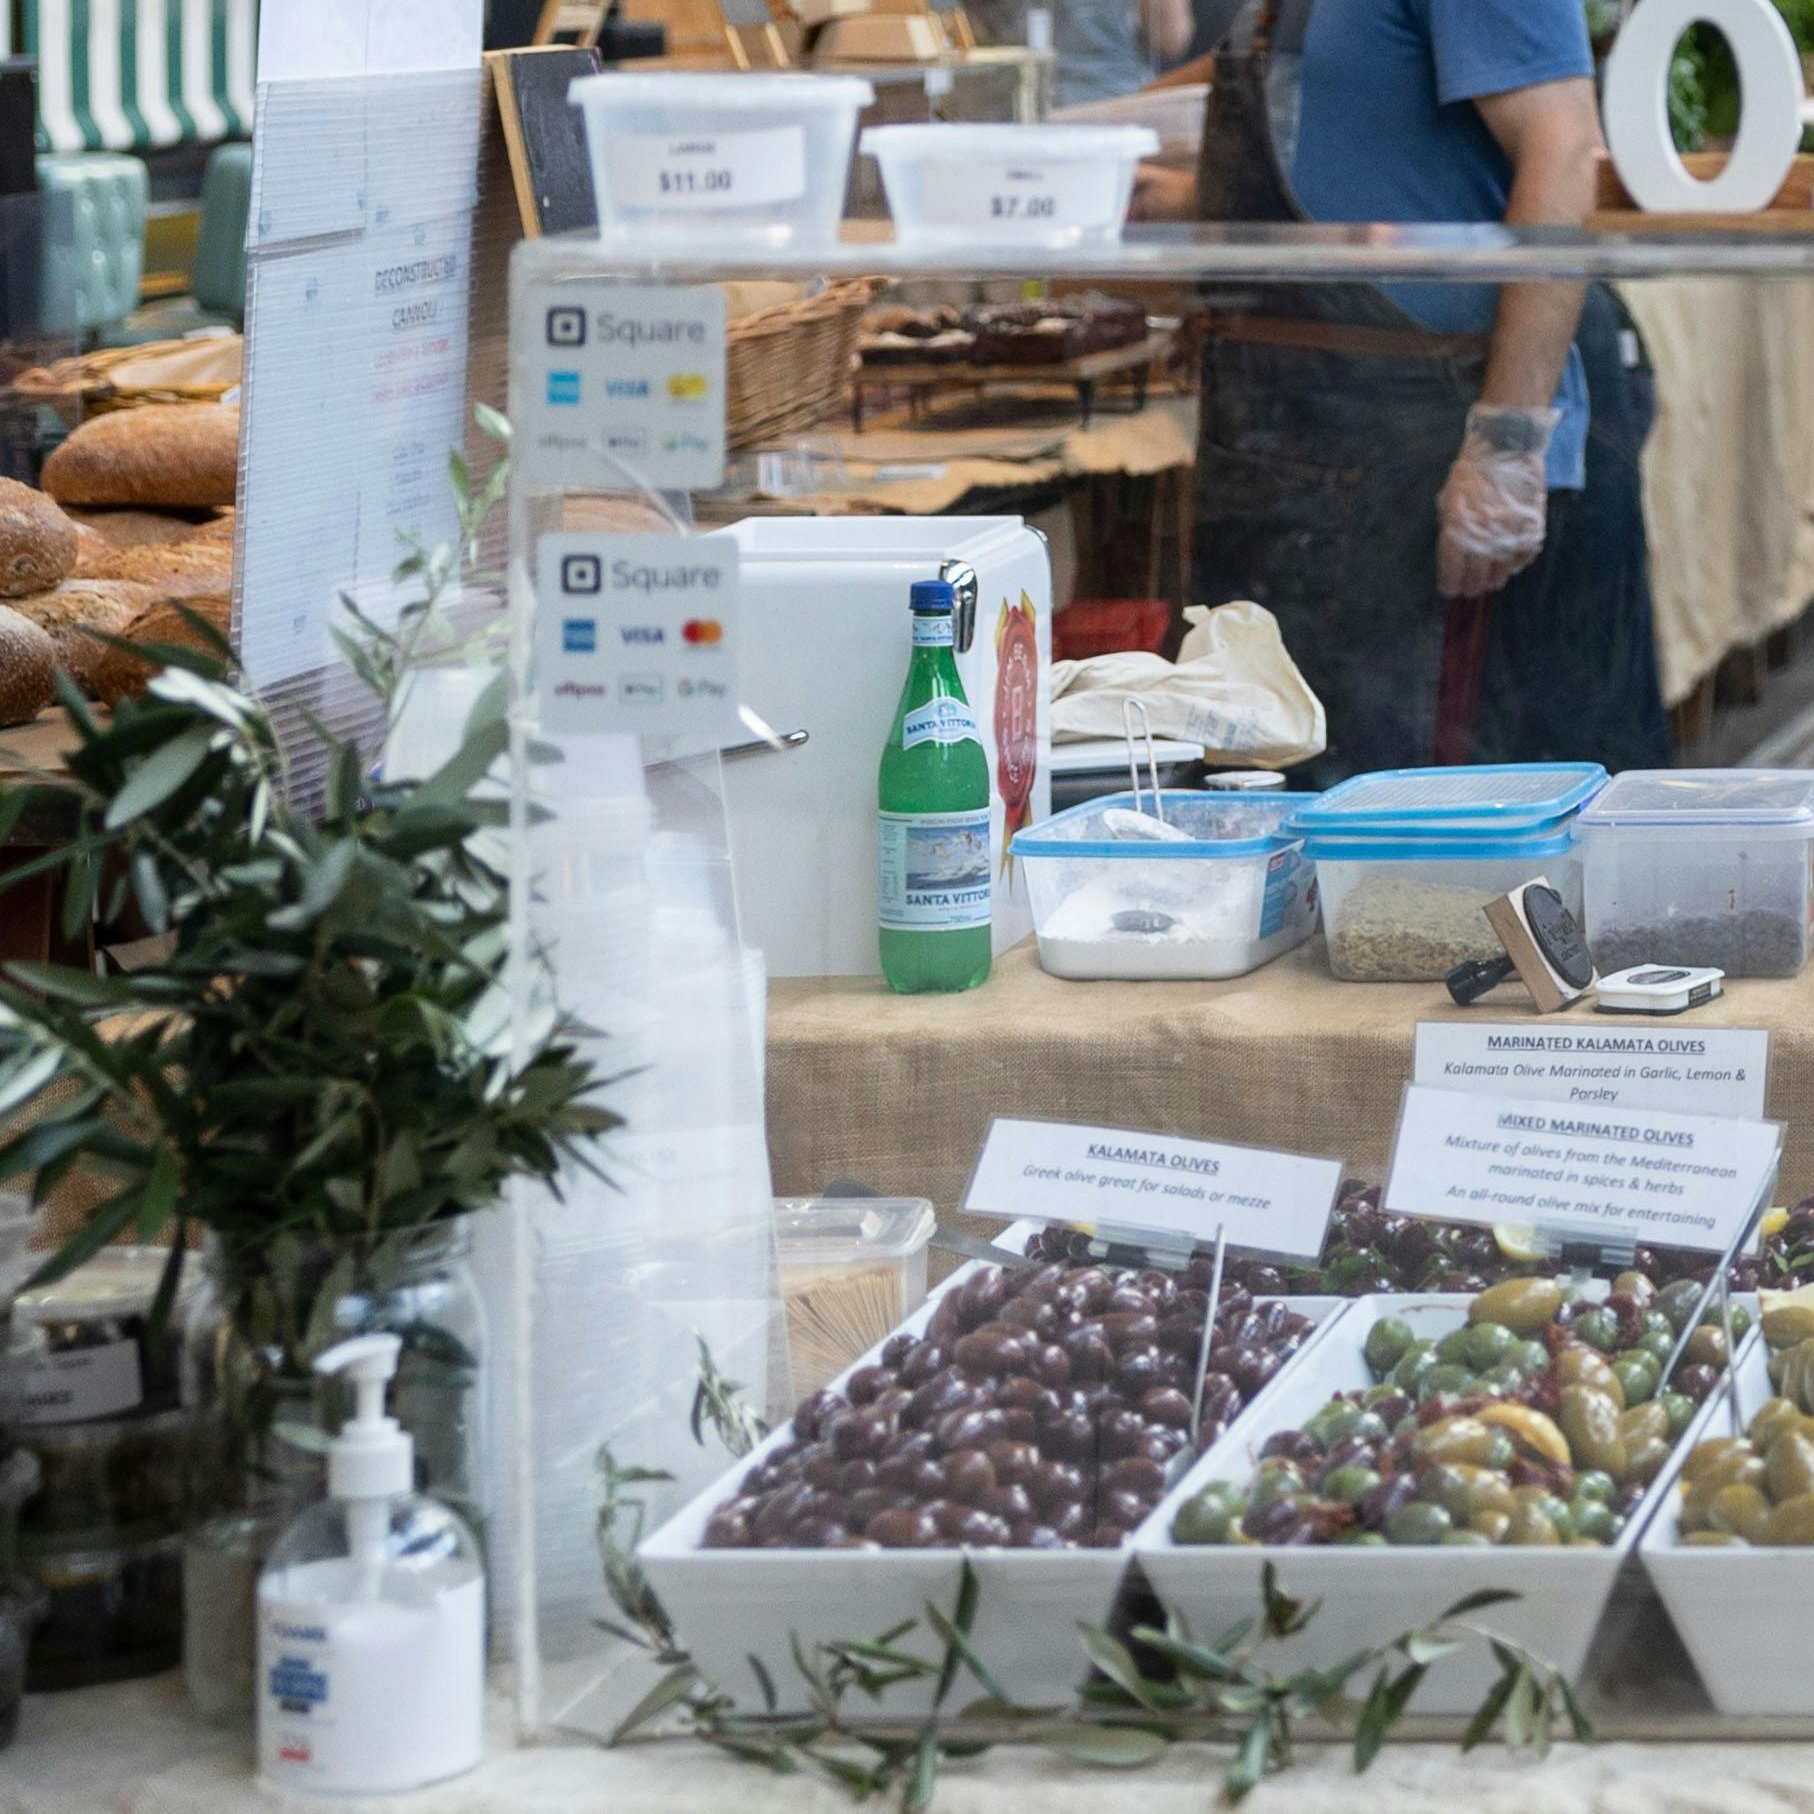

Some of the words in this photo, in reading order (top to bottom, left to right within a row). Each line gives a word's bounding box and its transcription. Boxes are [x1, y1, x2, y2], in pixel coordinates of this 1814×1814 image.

[660, 170, 733, 193] $11.00
[990, 196, 1056, 218] $7.00
[597, 313, 706, 348] Square
[612, 559, 722, 593] Square
[620, 627, 665, 645] VISA
[906, 720, 937, 734] SANTA
[906, 894, 949, 906] SANTA
[1487, 1036, 1573, 1051] MARINATED
[1576, 1038, 1653, 1053] KALAMATA
[1657, 1039, 1705, 1055] OLIVES
[1444, 1062, 1508, 1077] Kalamata
[1513, 1064, 1545, 1078] Olive
[1549, 1065, 1621, 1079] Marinated
[1624, 1066, 1636, 1078] in
[1639, 1066, 1682, 1082] Garlic,
[1686, 1068, 1732, 1081] Lemon
[1570, 1087, 1618, 1102] Parsley
[1498, 1113, 1546, 1131] MIXED
[1550, 1118, 1640, 1140] MARINATED
[1642, 1128, 1694, 1148] OLIVES
[1087, 1143, 1166, 1167] KALAMATA
[1170, 1154, 1220, 1174] OLIVES
[1445, 1135, 1501, 1153] Mixture
[1503, 1140, 1520, 1157] of
[1522, 1143, 1561, 1160] olives
[1564, 1148, 1600, 1166] from
[1603, 1151, 1626, 1166] the
[1630, 1155, 1737, 1179] Mediterranean
[1023, 1164, 1061, 1180] Greek
[1064, 1170, 1095, 1184] olive
[1097, 1174, 1136, 1190] great
[1137, 1178, 1160, 1195] for
[1161, 1183, 1206, 1200] salads
[1228, 1194, 1271, 1210] mezze
[1489, 1162, 1563, 1182] marinated
[1583, 1172, 1625, 1191] spices
[1645, 1178, 1684, 1195] herbs
[1446, 1185, 1466, 1198] An
[1469, 1188, 1534, 1207] all-round
[1538, 1195, 1571, 1210] olive
[1574, 1200, 1600, 1214] mix
[1601, 1202, 1623, 1218] for
[1627, 1205, 1716, 1229] entertaining
